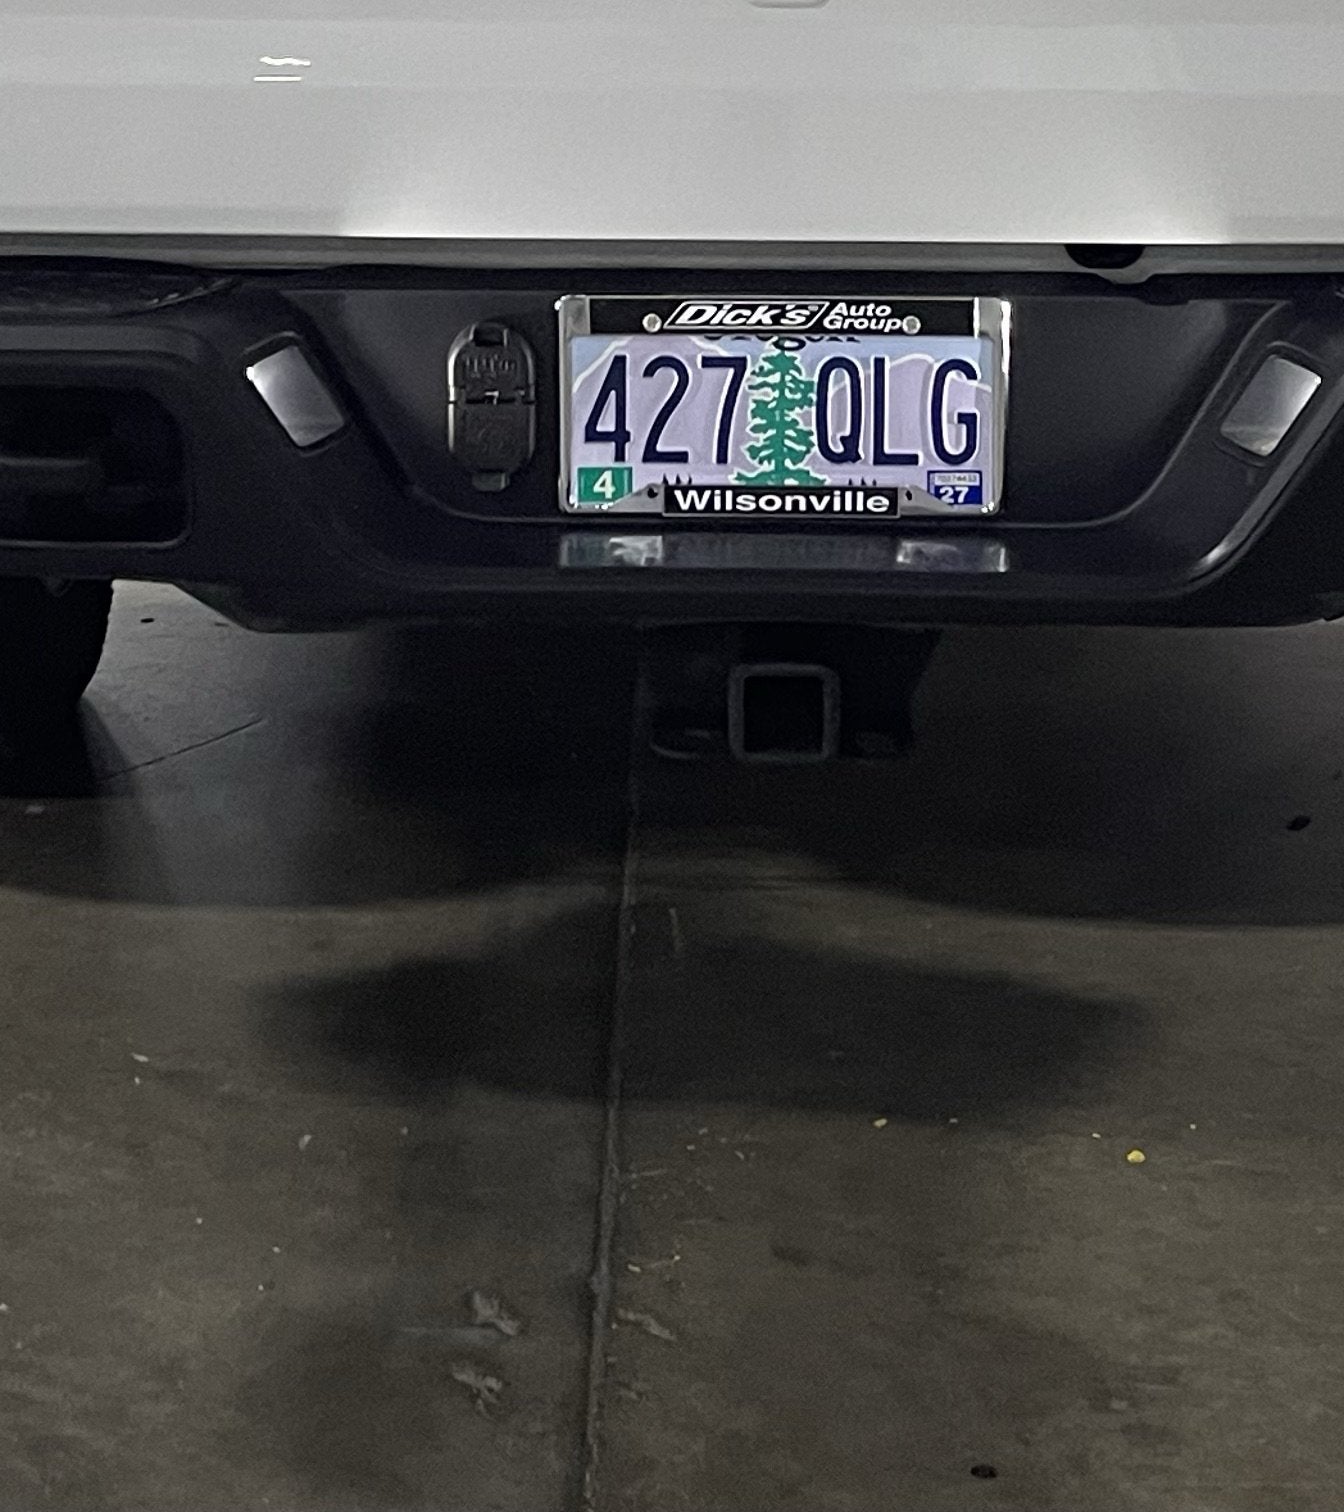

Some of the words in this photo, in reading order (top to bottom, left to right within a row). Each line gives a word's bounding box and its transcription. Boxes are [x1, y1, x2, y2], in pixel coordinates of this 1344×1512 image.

[675, 302, 811, 326] Dick's
[831, 301, 893, 318] Auto
[822, 314, 904, 333] Group
[583, 354, 748, 465] 427
[816, 358, 979, 467] QLG
[592, 471, 617, 499] 4
[939, 486, 969, 504] 27
[673, 489, 891, 513] Wilsonville
